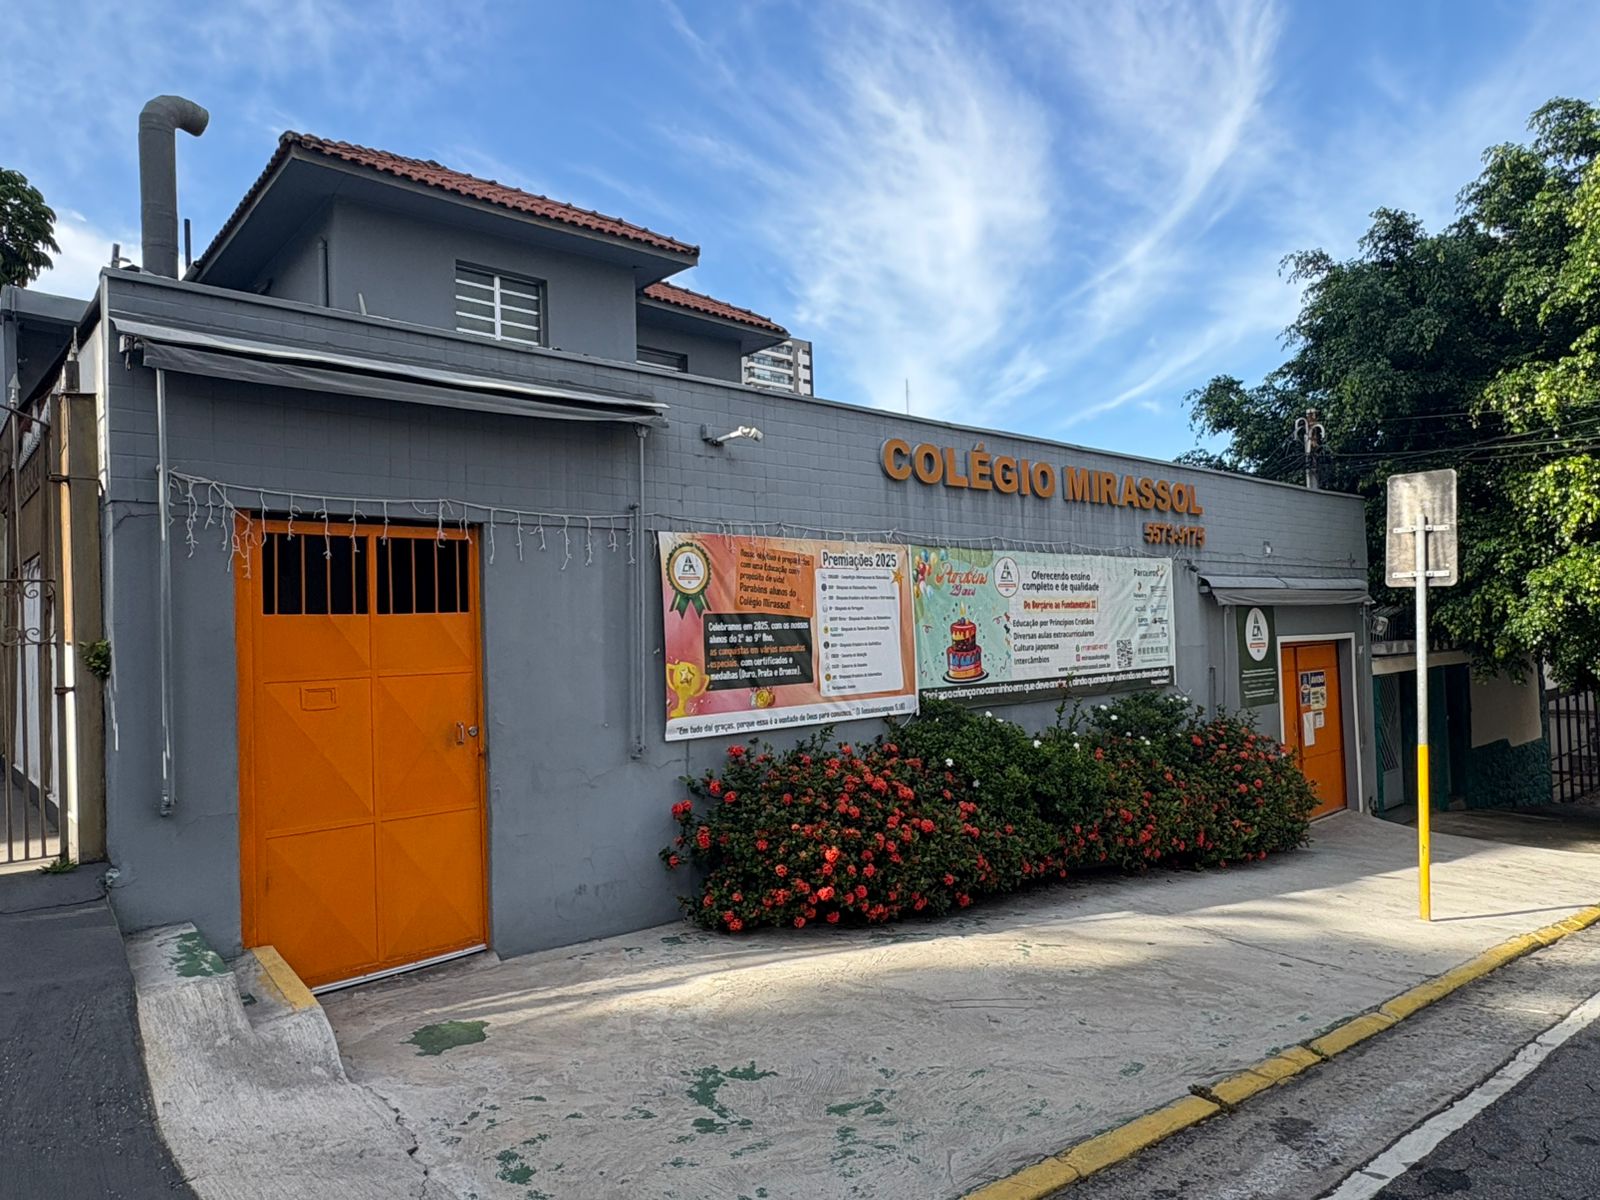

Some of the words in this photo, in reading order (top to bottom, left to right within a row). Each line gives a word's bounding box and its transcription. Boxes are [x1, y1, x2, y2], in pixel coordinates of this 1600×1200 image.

[881, 438, 1055, 499] COLÉGIO
[1064, 466, 1204, 515] MIRASSOL
[822, 551, 874, 570] Premiações
[875, 553, 897, 568] 2025
[764, 563, 788, 574] Educação
[936, 562, 988, 584] Parabéns
[740, 572, 764, 582] propósito
[1032, 570, 1070, 580] Oferecendo
[1070, 572, 1090, 581] ensino
[740, 582, 768, 594] Parabéns
[769, 586, 788, 596] alunos
[789, 588, 796, 598] do
[950, 584, 962, 596] 29
[1022, 582, 1054, 592] completo
[1060, 582, 1068, 591] de
[1070, 582, 1100, 594] qualidade
[740, 596, 762, 608] Colégio
[1024, 600, 1030, 610] Do
[1062, 600, 1090, 609] Fundamental
[1091, 600, 1096, 608] II
[708, 622, 742, 632] Celebramos
[743, 623, 752, 631] em
[771, 622, 782, 630] com
[783, 622, 790, 630] os
[790, 621, 808, 630] nossos
[1013, 619, 1039, 628] Educação
[1040, 620, 1049, 628] por
[1050, 618, 1074, 628] Princípios
[1075, 618, 1094, 626] Cristãos
[709, 634, 728, 644] alunos
[728, 634, 737, 643] do
[745, 634, 752, 642] ao
[1013, 632, 1037, 640] Diversas
[1038, 632, 1052, 640] aulas
[1053, 630, 1094, 639] extracurriculares
[709, 648, 718, 656] as
[718, 646, 750, 658] conquistas
[750, 646, 759, 654] em
[760, 644, 778, 654] vários
[779, 643, 806, 653] momentos
[1014, 644, 1034, 652] Cultura
[1035, 643, 1060, 652] japonesa
[740, 659, 753, 667] com
[754, 656, 788, 666] certificados
[1014, 656, 1050, 666] Intercâmbios
[710, 670, 738, 681] medalhas
[739, 669, 758, 680] (Ouro,
[758, 668, 774, 678] Prata
[953, 688, 976, 700] criança
[985, 684, 1012, 694] caminho
[1024, 683, 1035, 693] que
[1036, 680, 1049, 690] deve
[1088, 674, 1107, 687] quando
[690, 725, 703, 734] tudo
[736, 720, 755, 730] porque
[756, 720, 768, 728] essa
[778, 715, 799, 724] vontade
[799, 714, 806, 722] de
[806, 712, 818, 720] Deus
[819, 711, 830, 720] para
